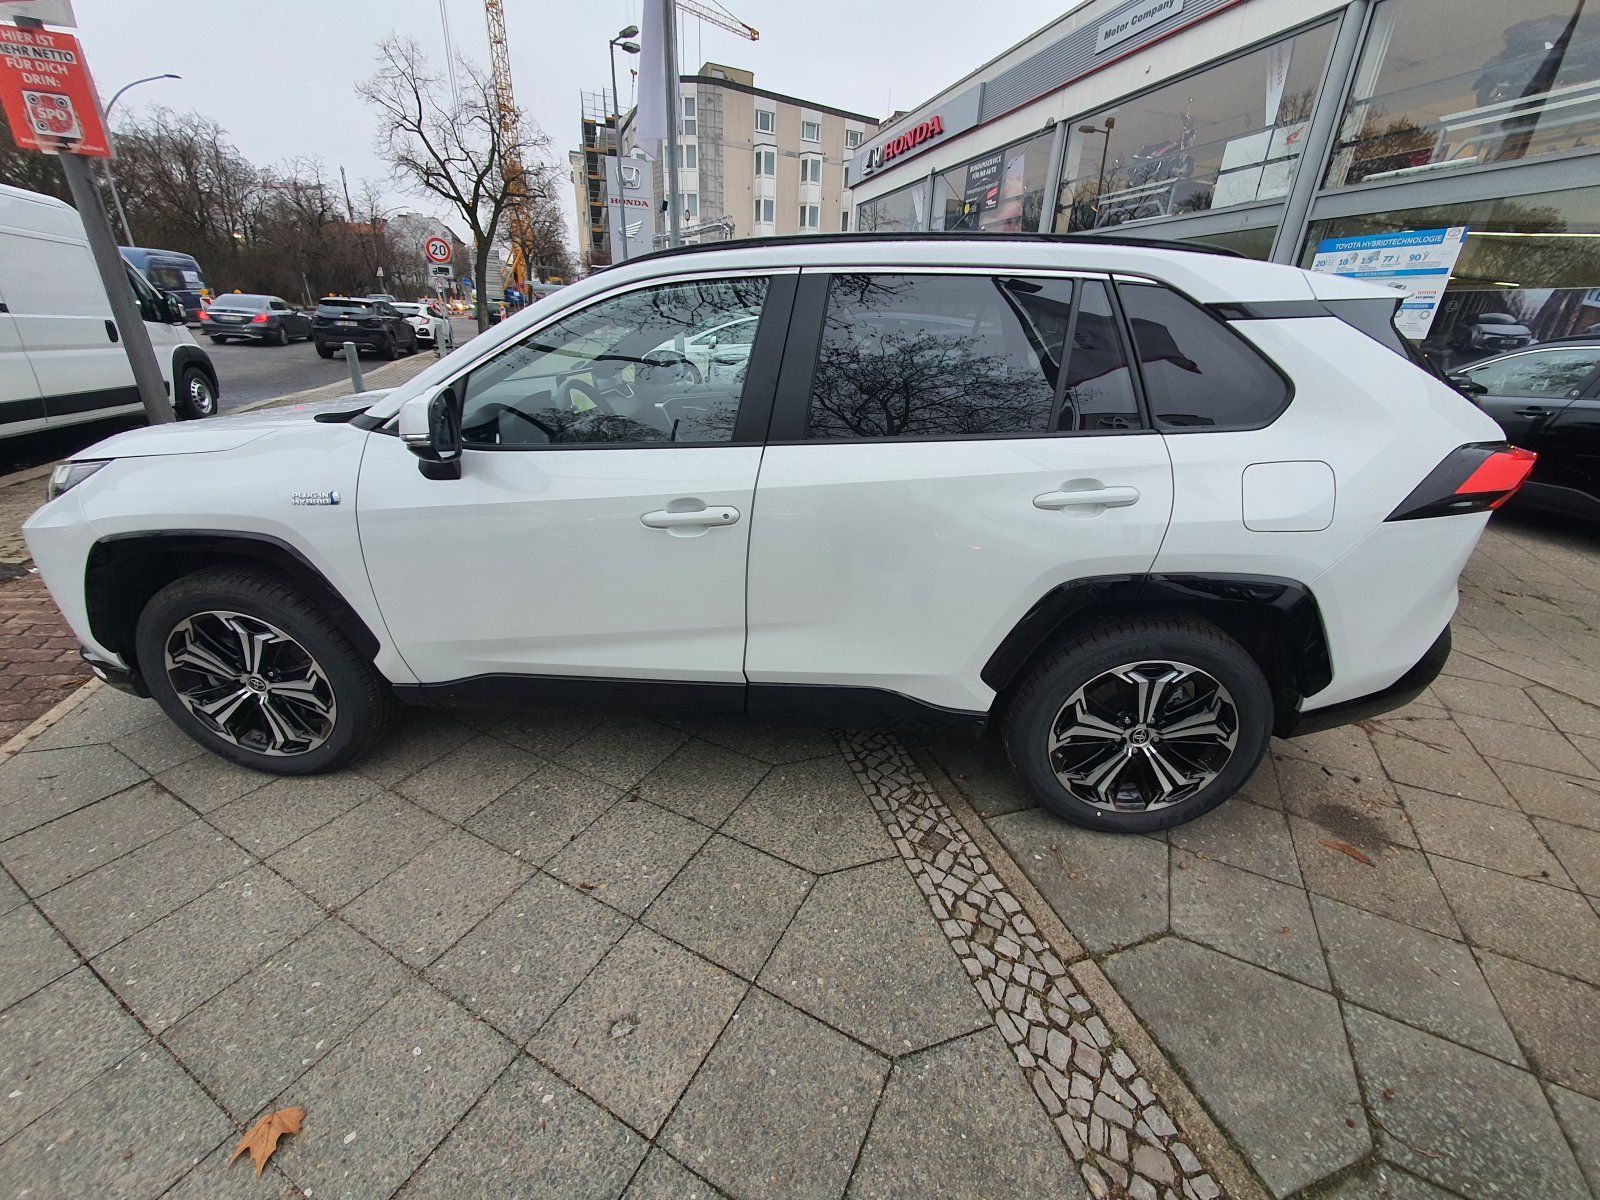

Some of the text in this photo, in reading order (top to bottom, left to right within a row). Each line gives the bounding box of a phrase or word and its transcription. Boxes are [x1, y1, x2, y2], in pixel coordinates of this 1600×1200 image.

[1104, 0, 1175, 41] Motor Company
[1, 30, 55, 47] HIER IST
[32, 47, 73, 61] NETTO
[34, 60, 69, 75] DICH
[22, 72, 61, 87] DRIN:
[883, 115, 943, 161] HONDA
[1361, 235, 1443, 247] HYBRIDTECHNOLOGIE
[431, 243, 446, 256] 20
[1315, 260, 1326, 268] 20
[1383, 255, 1395, 263] 77
